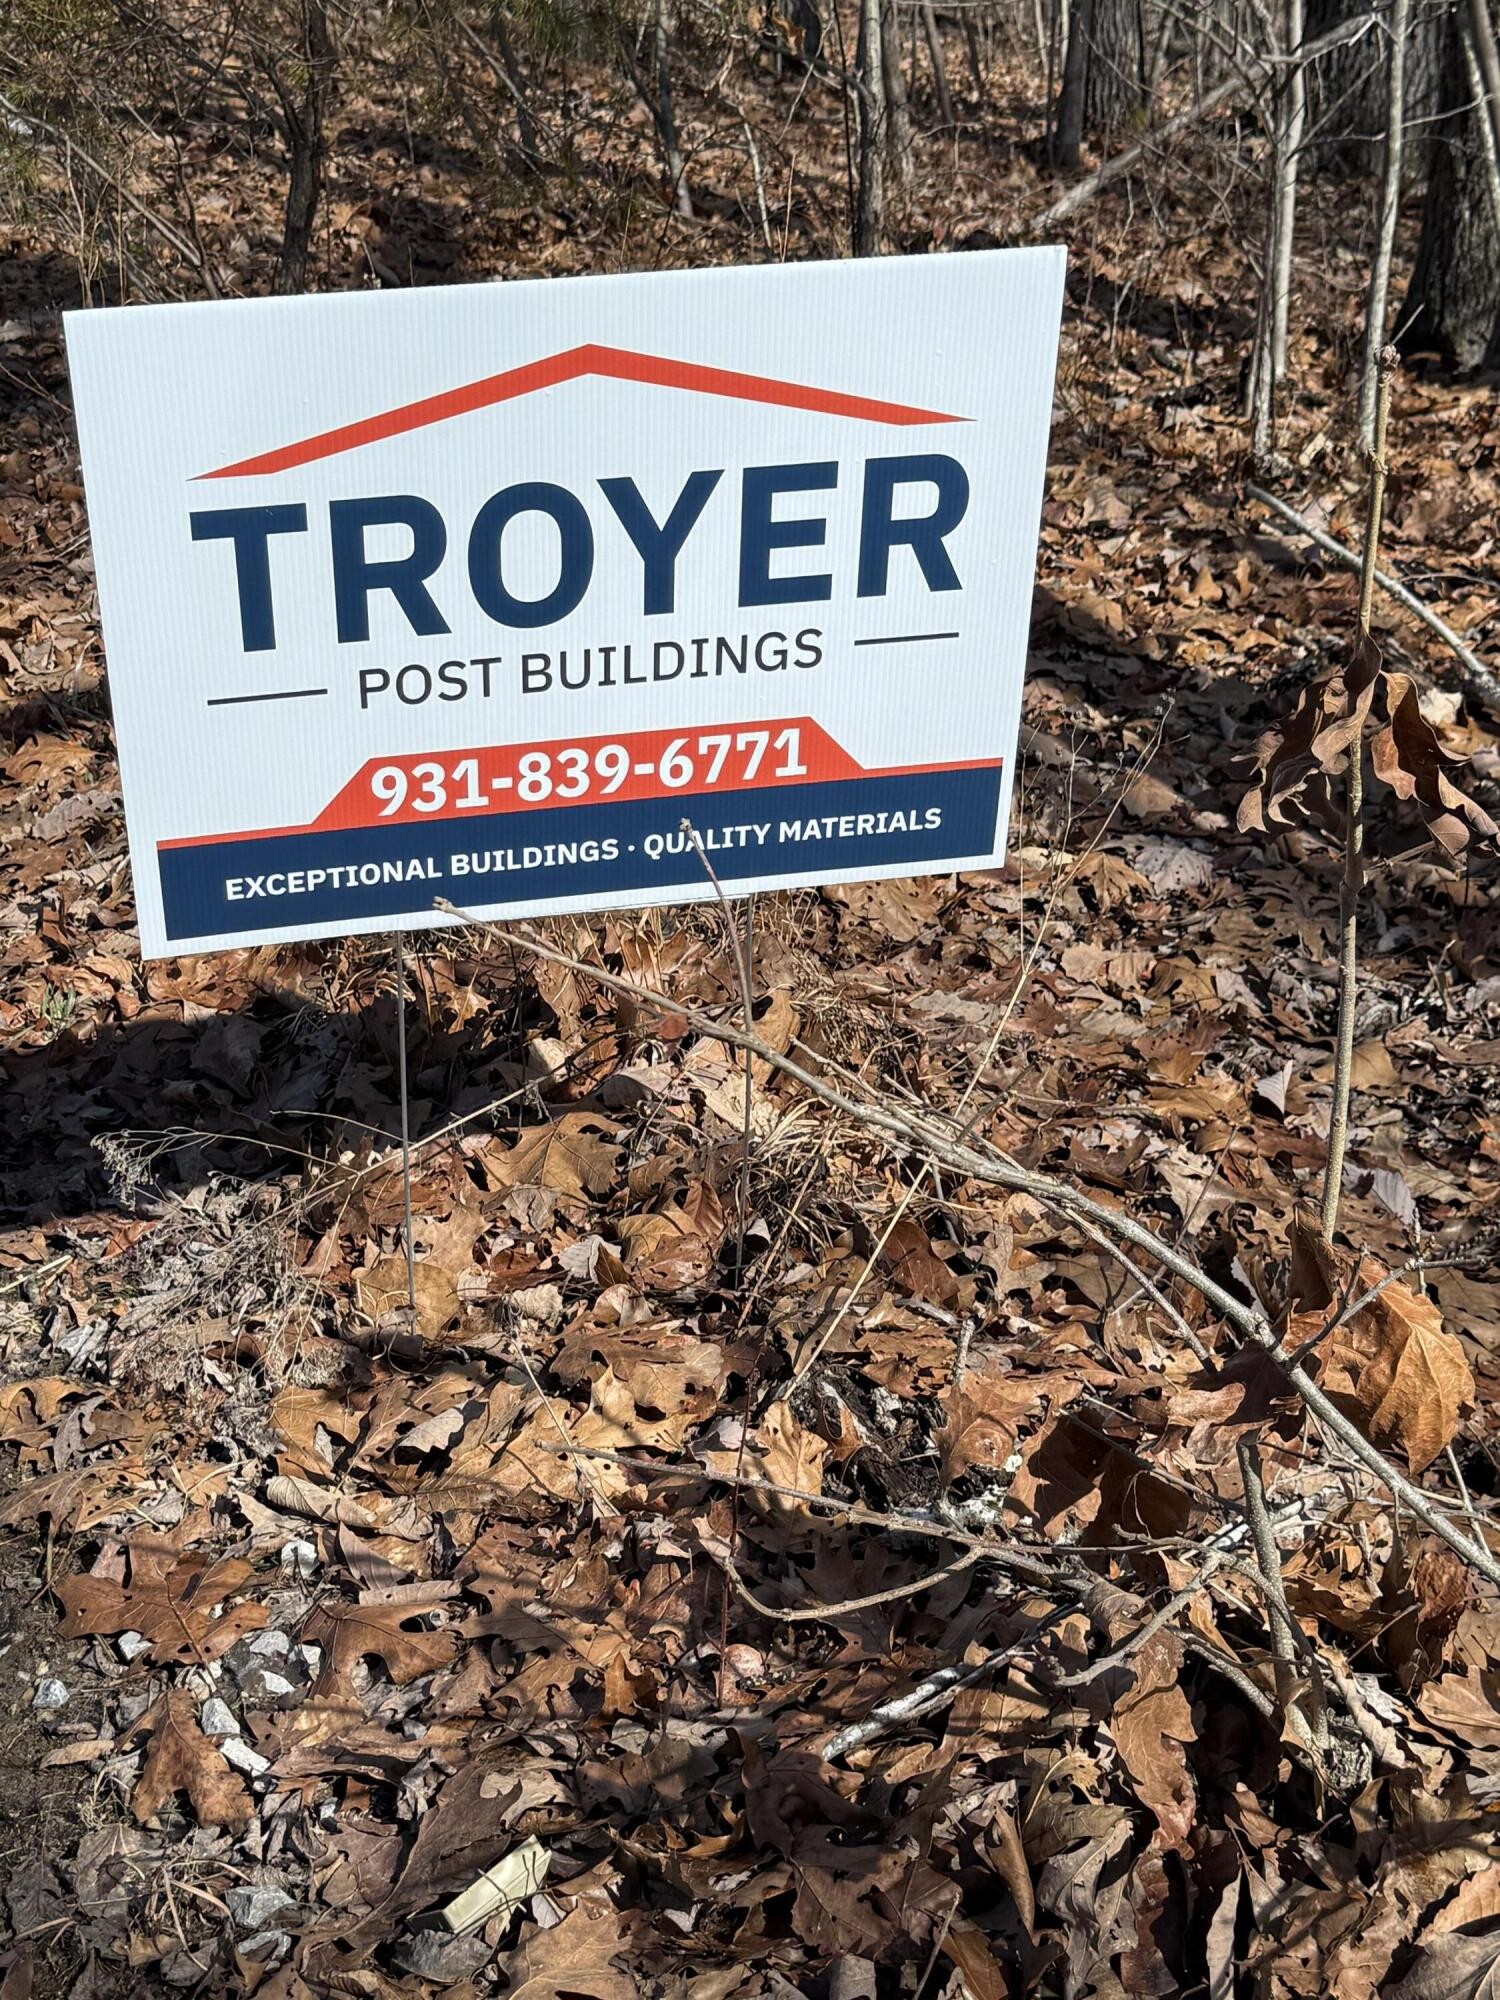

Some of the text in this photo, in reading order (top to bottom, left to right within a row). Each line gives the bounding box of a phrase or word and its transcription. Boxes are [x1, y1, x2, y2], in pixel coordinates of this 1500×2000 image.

[189, 453, 970, 653] TROYER
[359, 628, 823, 710] POST BUILDINGS
[369, 726, 808, 817] 931-839-6771
[225, 807, 942, 901] EXCEPTIONAL BUILDINGS QUALITY MATERIALS
